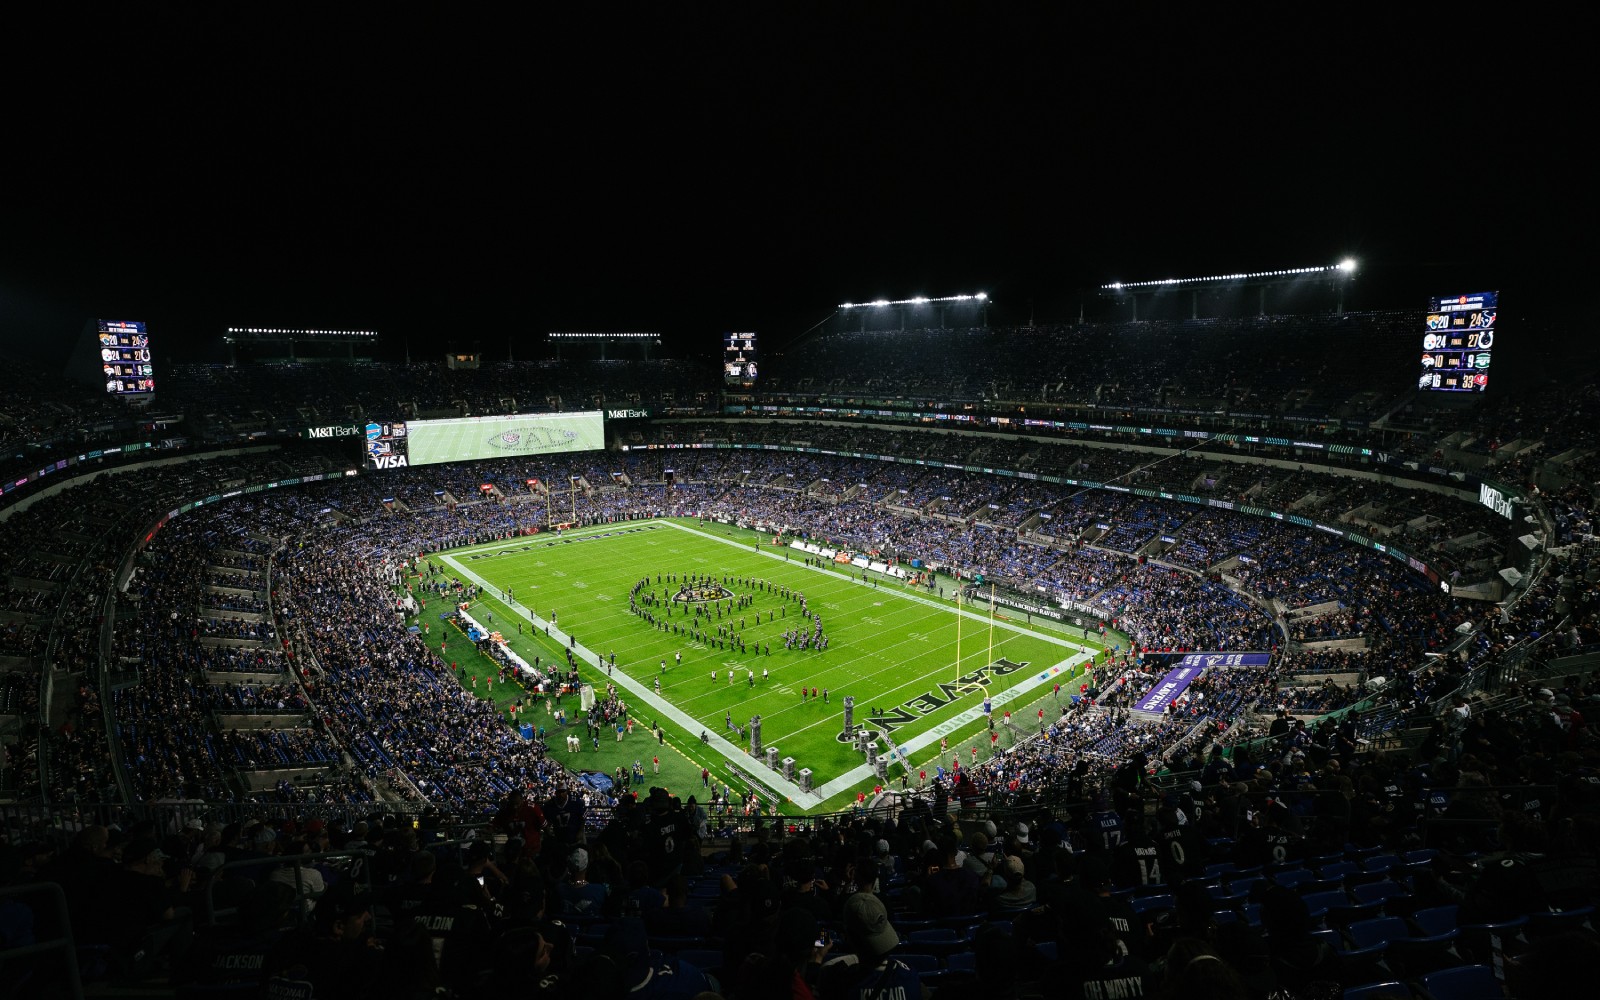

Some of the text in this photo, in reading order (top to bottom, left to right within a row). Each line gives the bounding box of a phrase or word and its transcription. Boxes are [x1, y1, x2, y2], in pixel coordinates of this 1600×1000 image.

[1438, 316, 1449, 328] 20
[1470, 313, 1481, 327] 24
[1436, 335, 1446, 348] 24
[1468, 334, 1479, 347] 27
[112, 350, 120, 360] 24
[1434, 354, 1444, 368] 10
[1467, 354, 1474, 368] 9
[114, 366, 121, 376] 10
[1432, 374, 1442, 388] 16
[1462, 375, 1474, 388] 33
[608, 408, 648, 418] M&T Bank
[308, 424, 360, 438] M&T Bank
[384, 425, 388, 435] 0
[374, 455, 408, 470] VISA
[1480, 483, 1512, 520] M&T Bank
[1142, 682, 1178, 710] RAVENS
[556, 813, 570, 828] 17
[1102, 830, 1121, 850] 17
[1164, 830, 1182, 840] SMITH
[664, 836, 675, 854] 0
[1171, 840, 1184, 864] 0
[351, 858, 362, 878] 8
[1138, 858, 1160, 885] 14
[212, 954, 264, 969] JACKSON
[1083, 976, 1144, 1000] OH WAYYY
